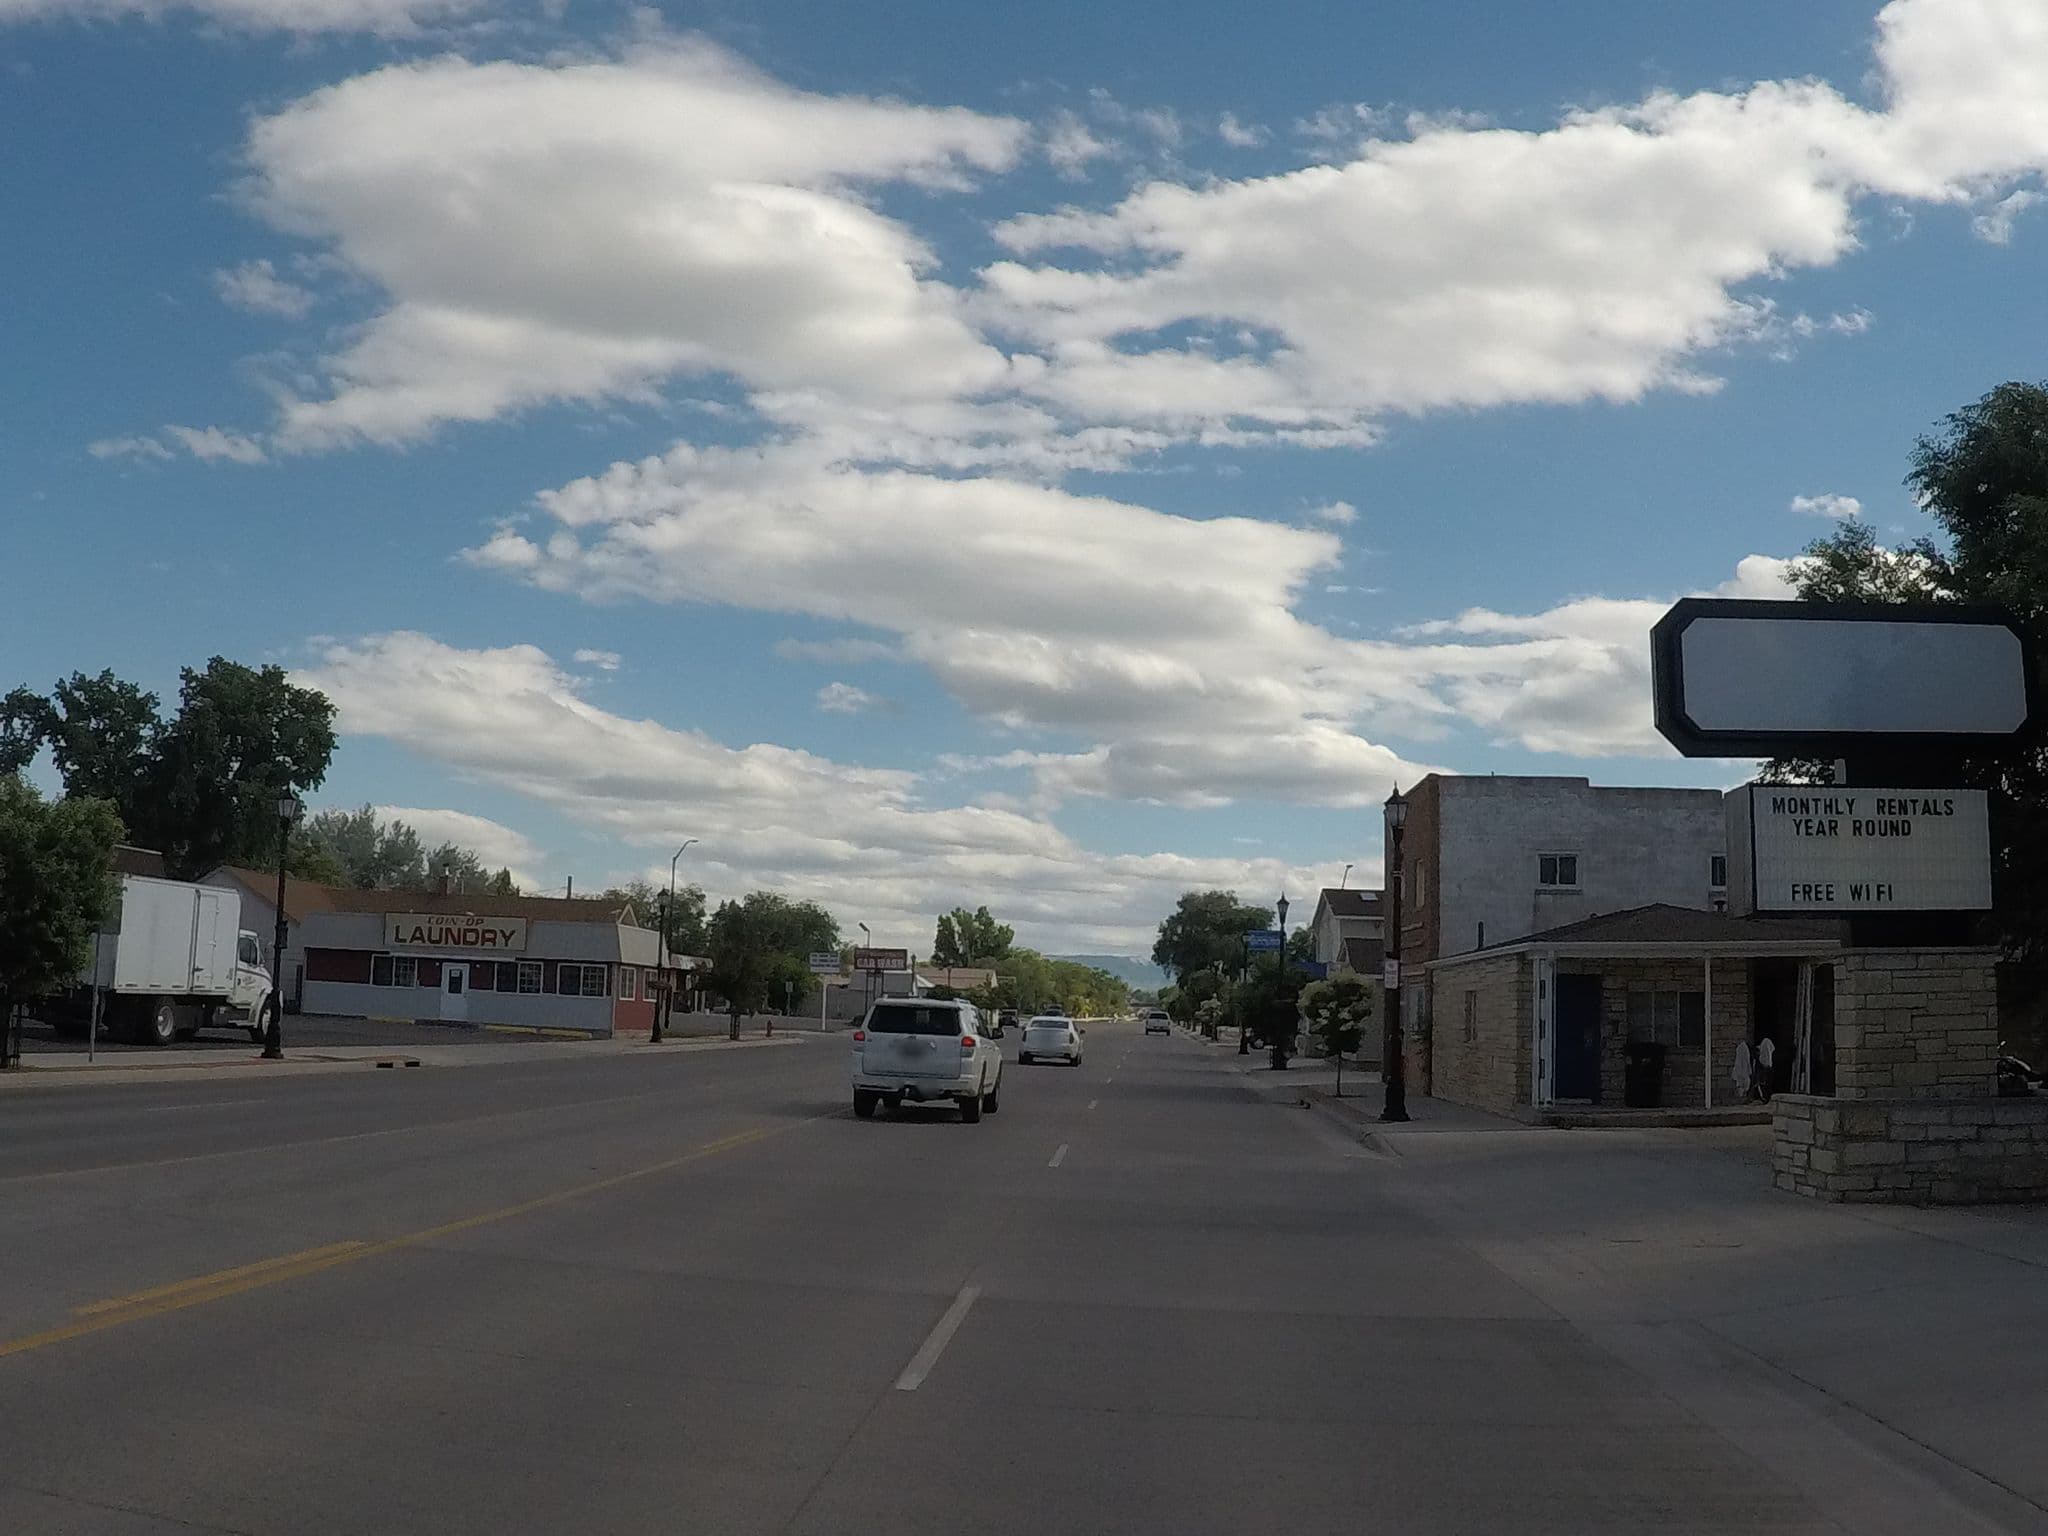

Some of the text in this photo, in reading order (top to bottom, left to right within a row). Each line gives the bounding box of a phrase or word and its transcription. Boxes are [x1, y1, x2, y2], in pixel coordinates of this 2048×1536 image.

[1772, 797, 1954, 816] MONTHLY RENTALS
[1793, 818, 1912, 837] YEAR ROUND
[1791, 883, 1835, 902] FREE
[394, 925, 516, 947] LAUNDRY
[856, 958, 876, 968] CAR
